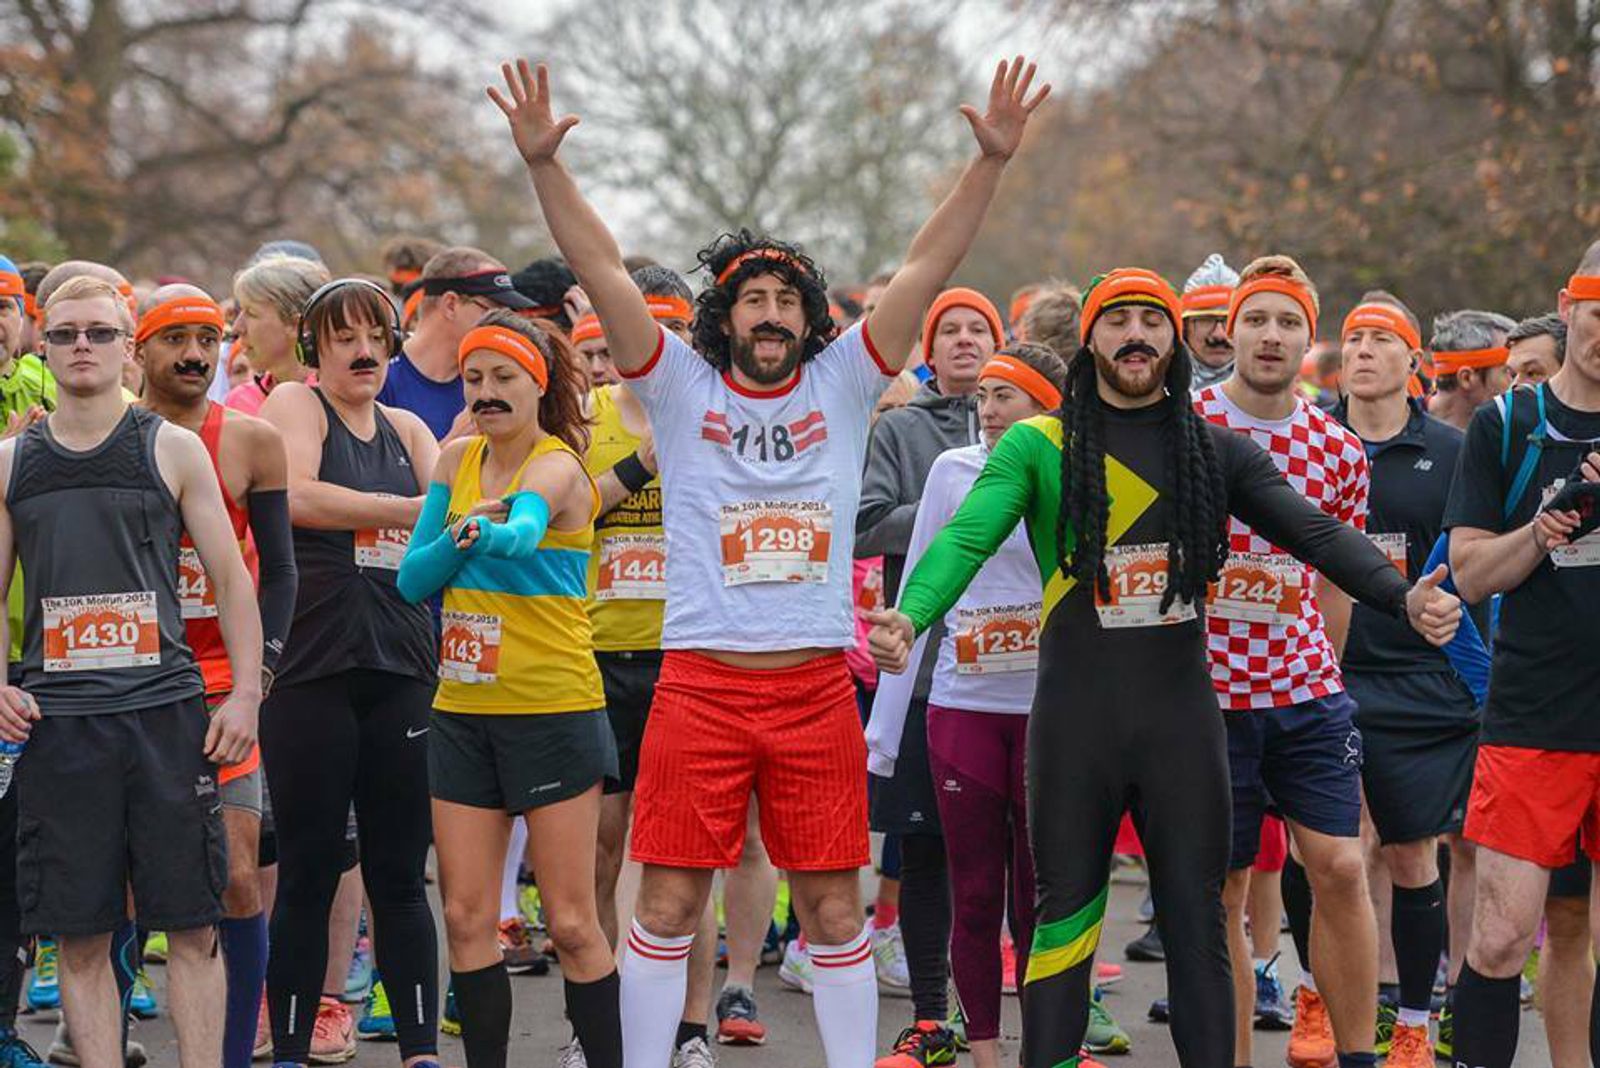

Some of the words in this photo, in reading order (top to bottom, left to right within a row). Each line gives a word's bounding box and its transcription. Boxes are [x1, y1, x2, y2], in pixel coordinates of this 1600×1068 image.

[732, 424, 795, 462] 118
[722, 505, 739, 514] The
[743, 502, 762, 512] 10K
[739, 527, 815, 552] 1298
[177, 574, 207, 598] 44
[1114, 570, 1168, 597] 129
[1213, 576, 1283, 603] 1244
[45, 599, 61, 608] The
[64, 598, 83, 607] 10K
[62, 621, 140, 649] 1430
[972, 626, 1040, 654] 1234
[443, 637, 482, 663] 143
